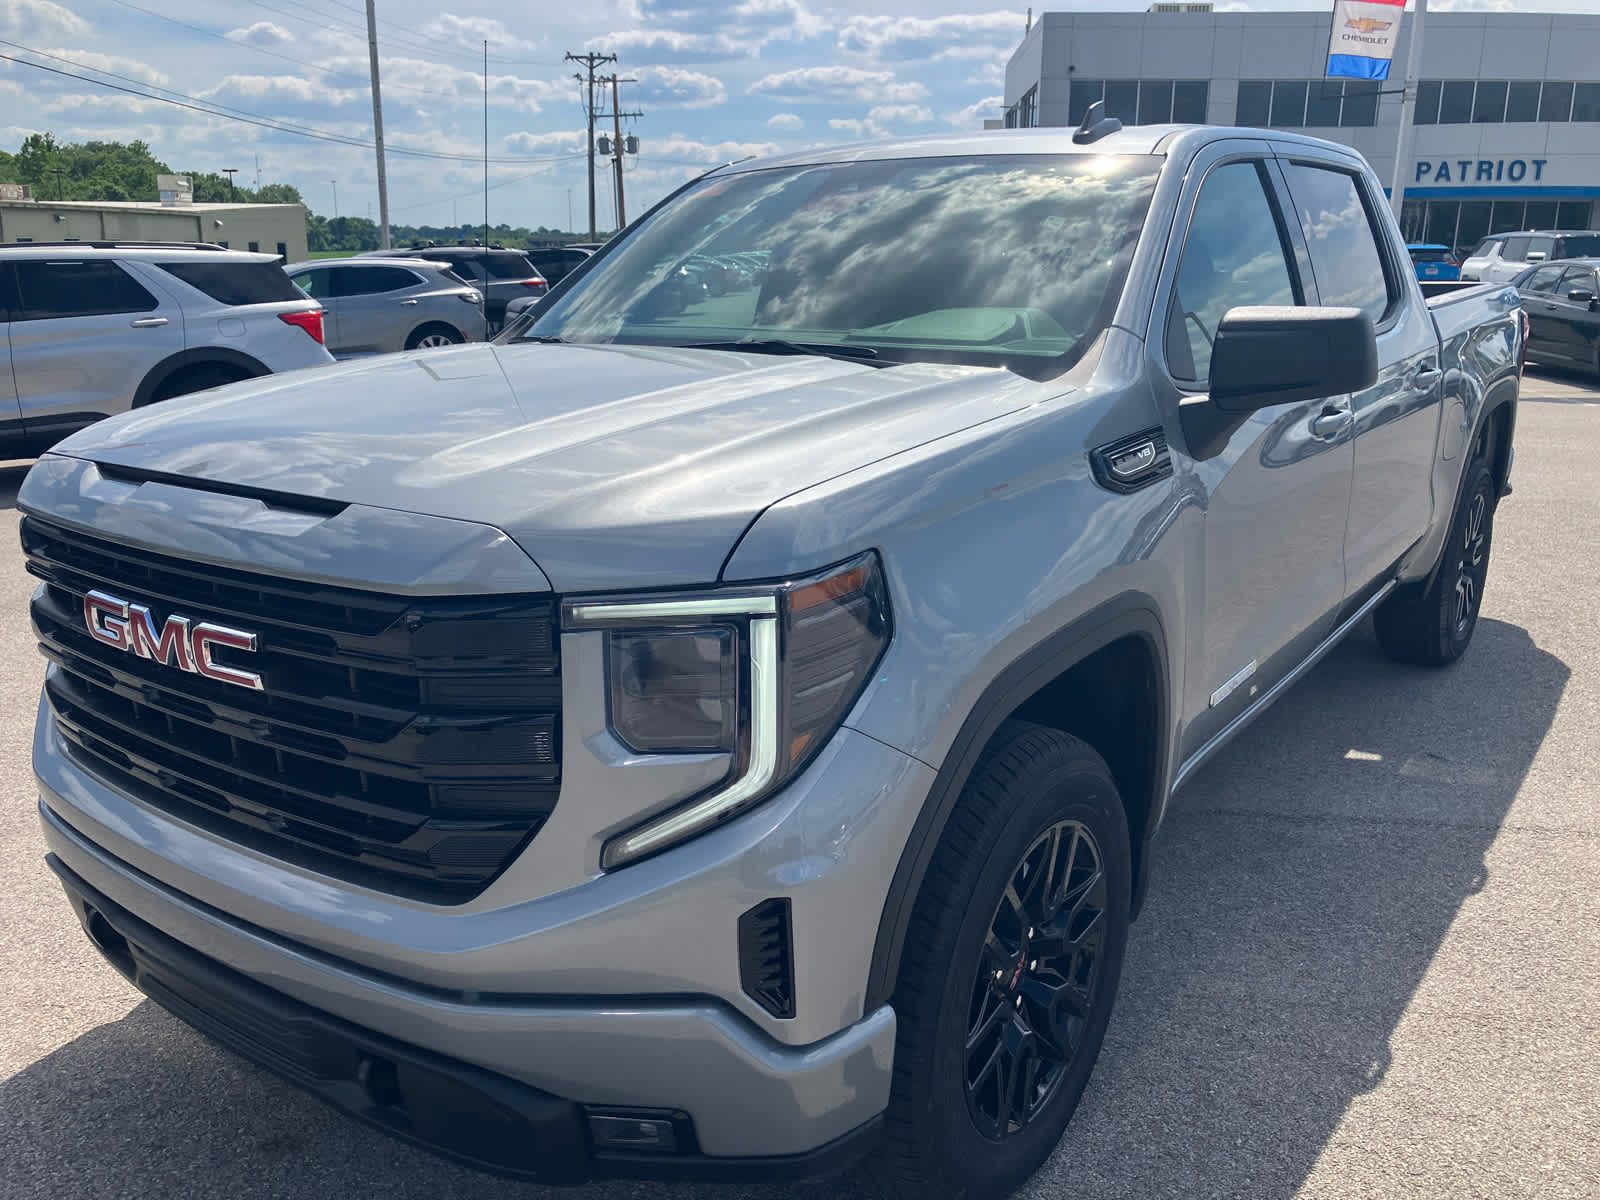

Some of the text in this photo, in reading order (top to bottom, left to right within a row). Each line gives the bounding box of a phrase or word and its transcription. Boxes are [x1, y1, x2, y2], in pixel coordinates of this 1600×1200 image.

[1342, 34, 1388, 45] CHEVROLET
[1415, 160, 1547, 182] PATRIOT
[1137, 447, 1151, 458] V8
[84, 589, 264, 690] GMC
